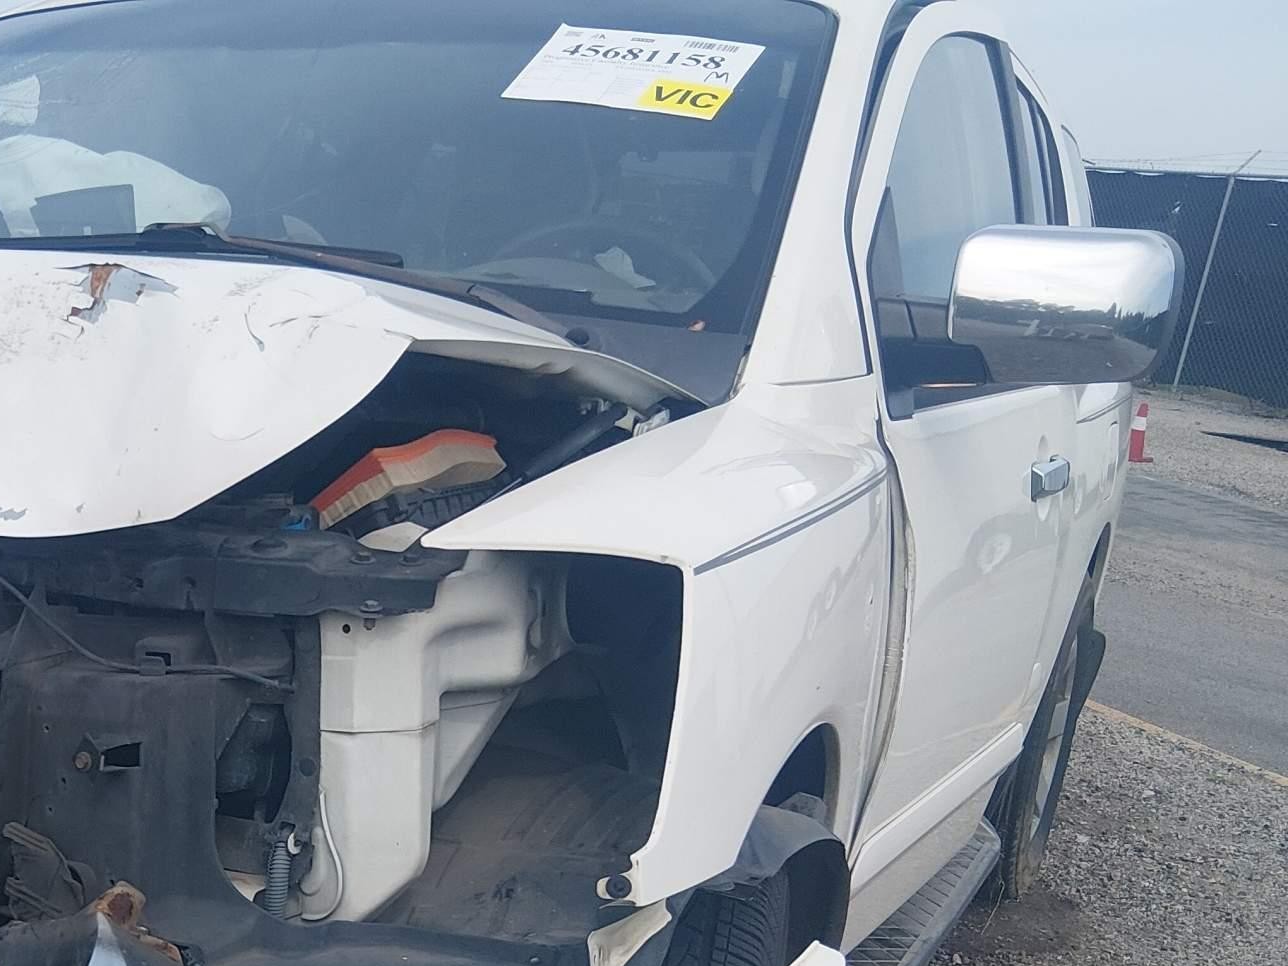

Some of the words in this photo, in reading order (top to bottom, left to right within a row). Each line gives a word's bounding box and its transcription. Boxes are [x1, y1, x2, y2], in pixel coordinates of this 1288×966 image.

[562, 43, 726, 70] 45681158
[704, 71, 729, 83] M
[654, 85, 719, 109] VIC
